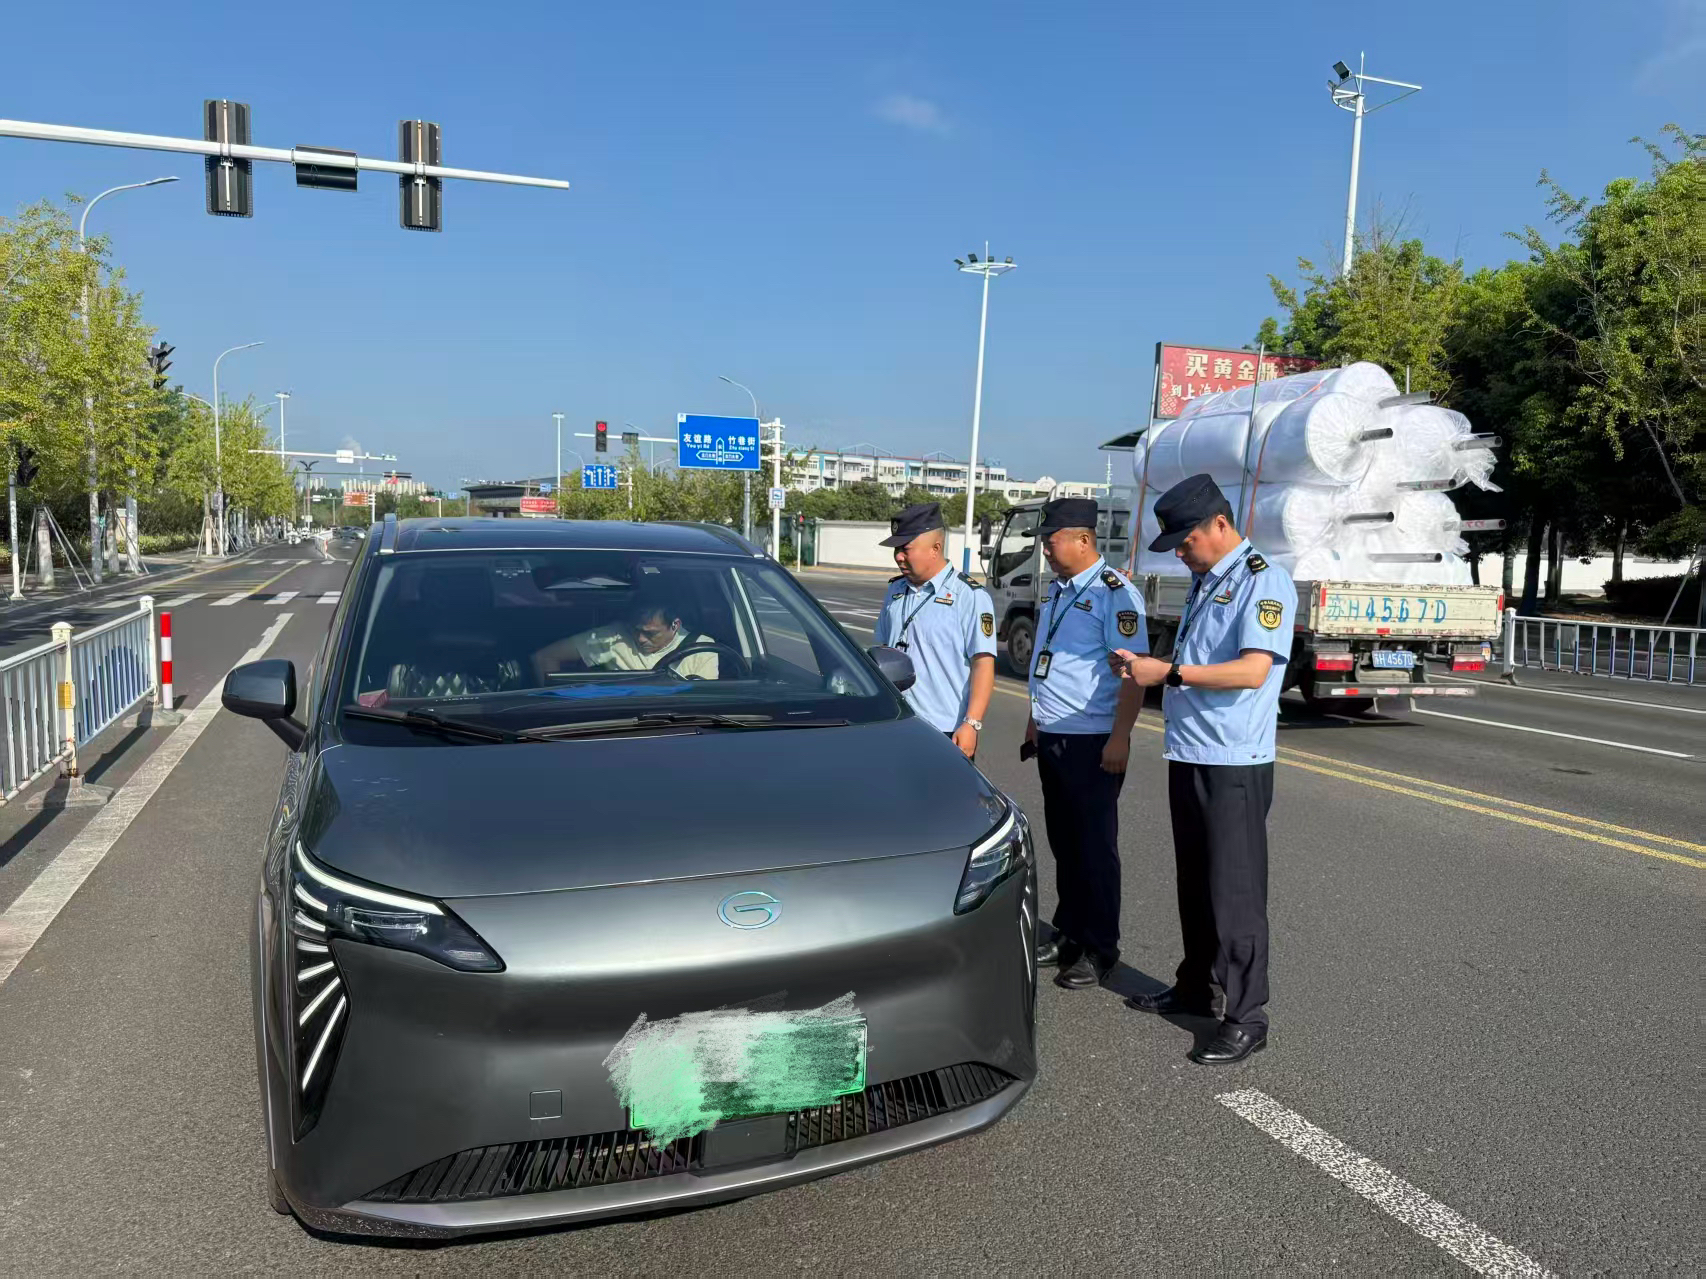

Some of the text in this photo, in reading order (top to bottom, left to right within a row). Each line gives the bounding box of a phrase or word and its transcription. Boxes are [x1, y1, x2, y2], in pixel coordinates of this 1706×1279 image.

[683, 433, 712, 444] 友谊路
[728, 436, 756, 446] 竹巷街
